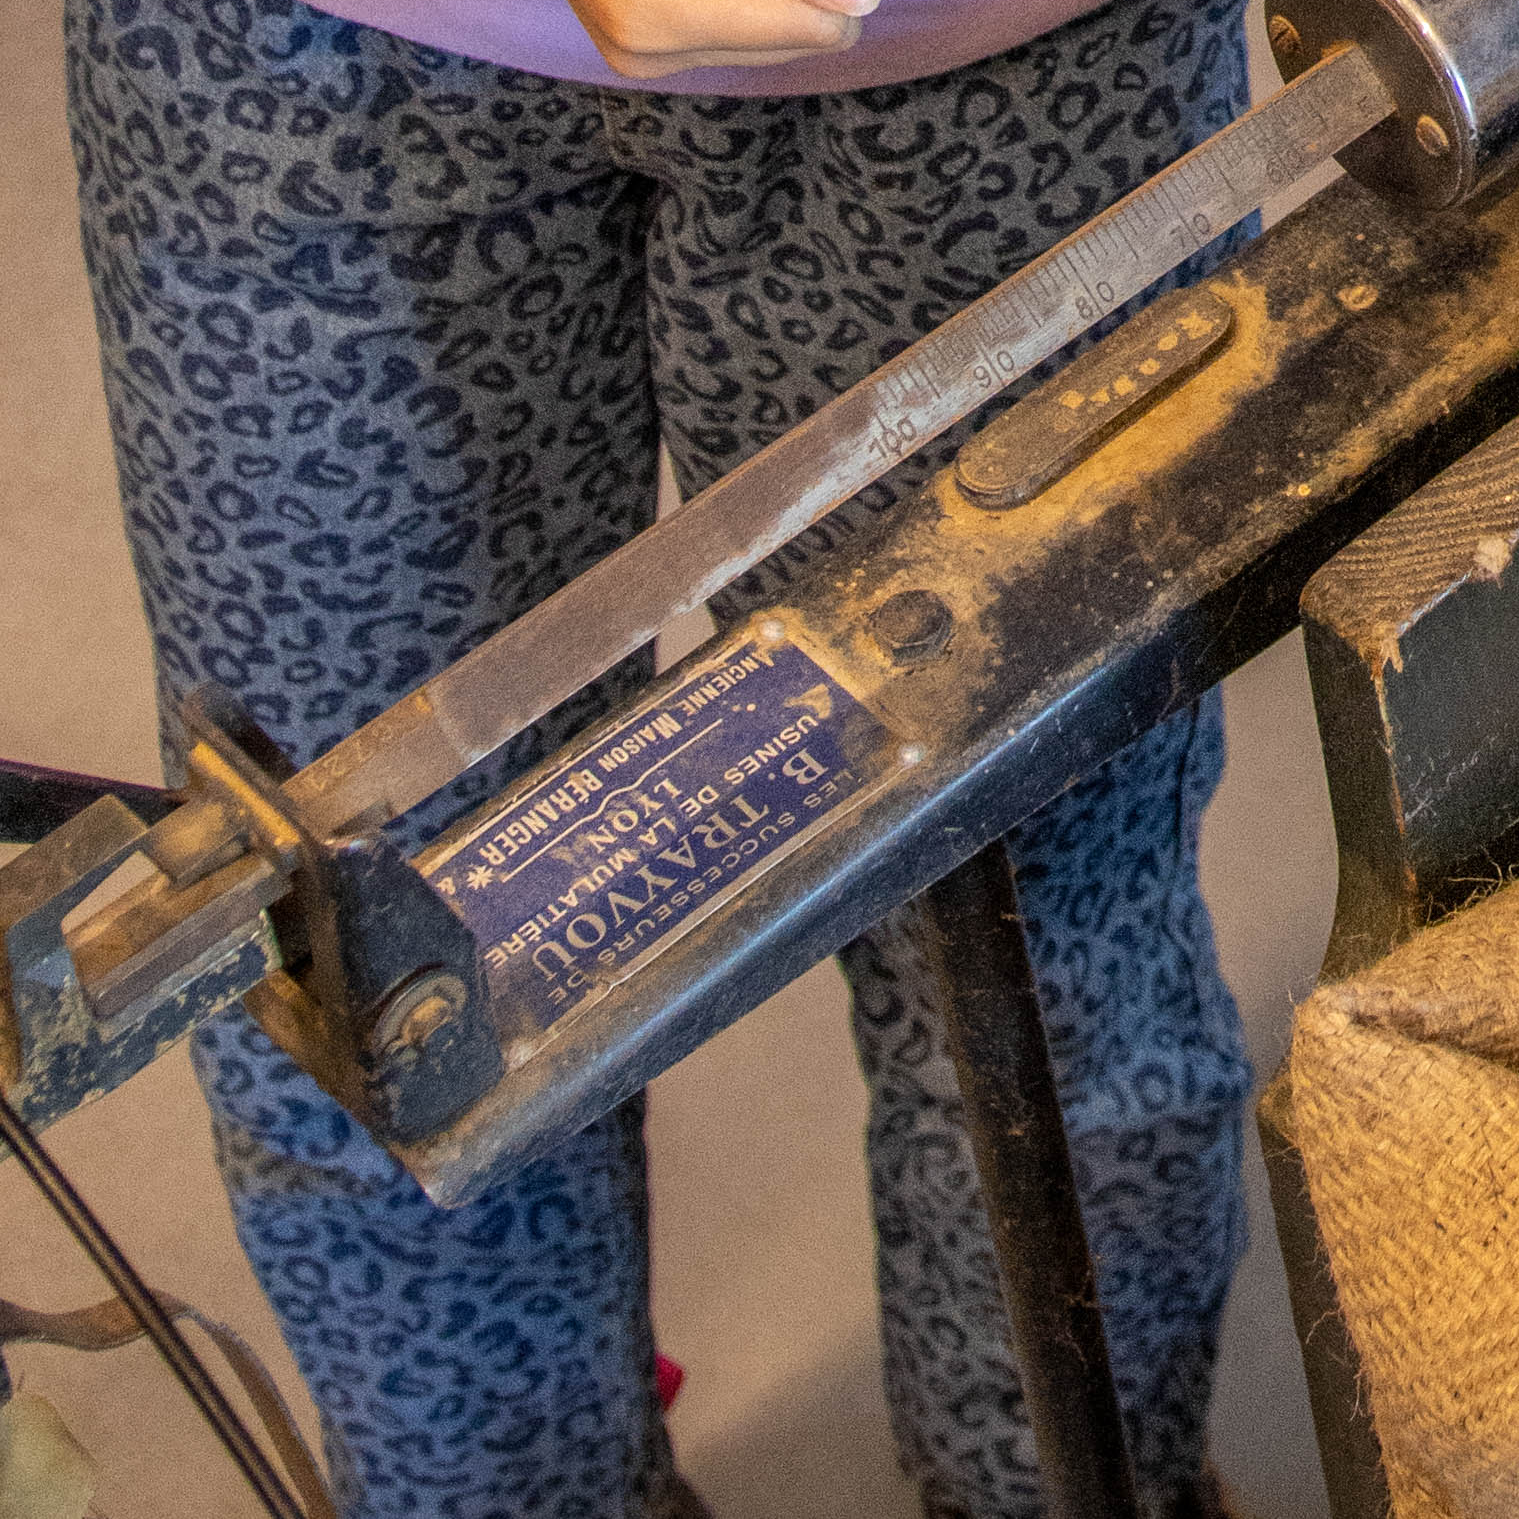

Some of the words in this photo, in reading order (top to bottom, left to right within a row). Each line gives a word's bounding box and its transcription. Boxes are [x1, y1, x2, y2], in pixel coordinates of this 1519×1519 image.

[1169, 213, 1210, 250] 70
[1075, 280, 1115, 320] 80
[973, 350, 1014, 389] 90
[868, 417, 918, 458] 100
[724, 715, 819, 785] USINES
[768, 748, 829, 785] B.
[678, 785, 720, 818] DE
[803, 770, 856, 809] LES
[479, 769, 604, 866] BÉRANGER
[587, 778, 683, 854] LYON
[637, 816, 677, 846] LA
[484, 847, 640, 969] MULATIÈRE
[532, 795, 769, 982] TRAYVOU
[598, 812, 796, 965] SUCCESSEURS
